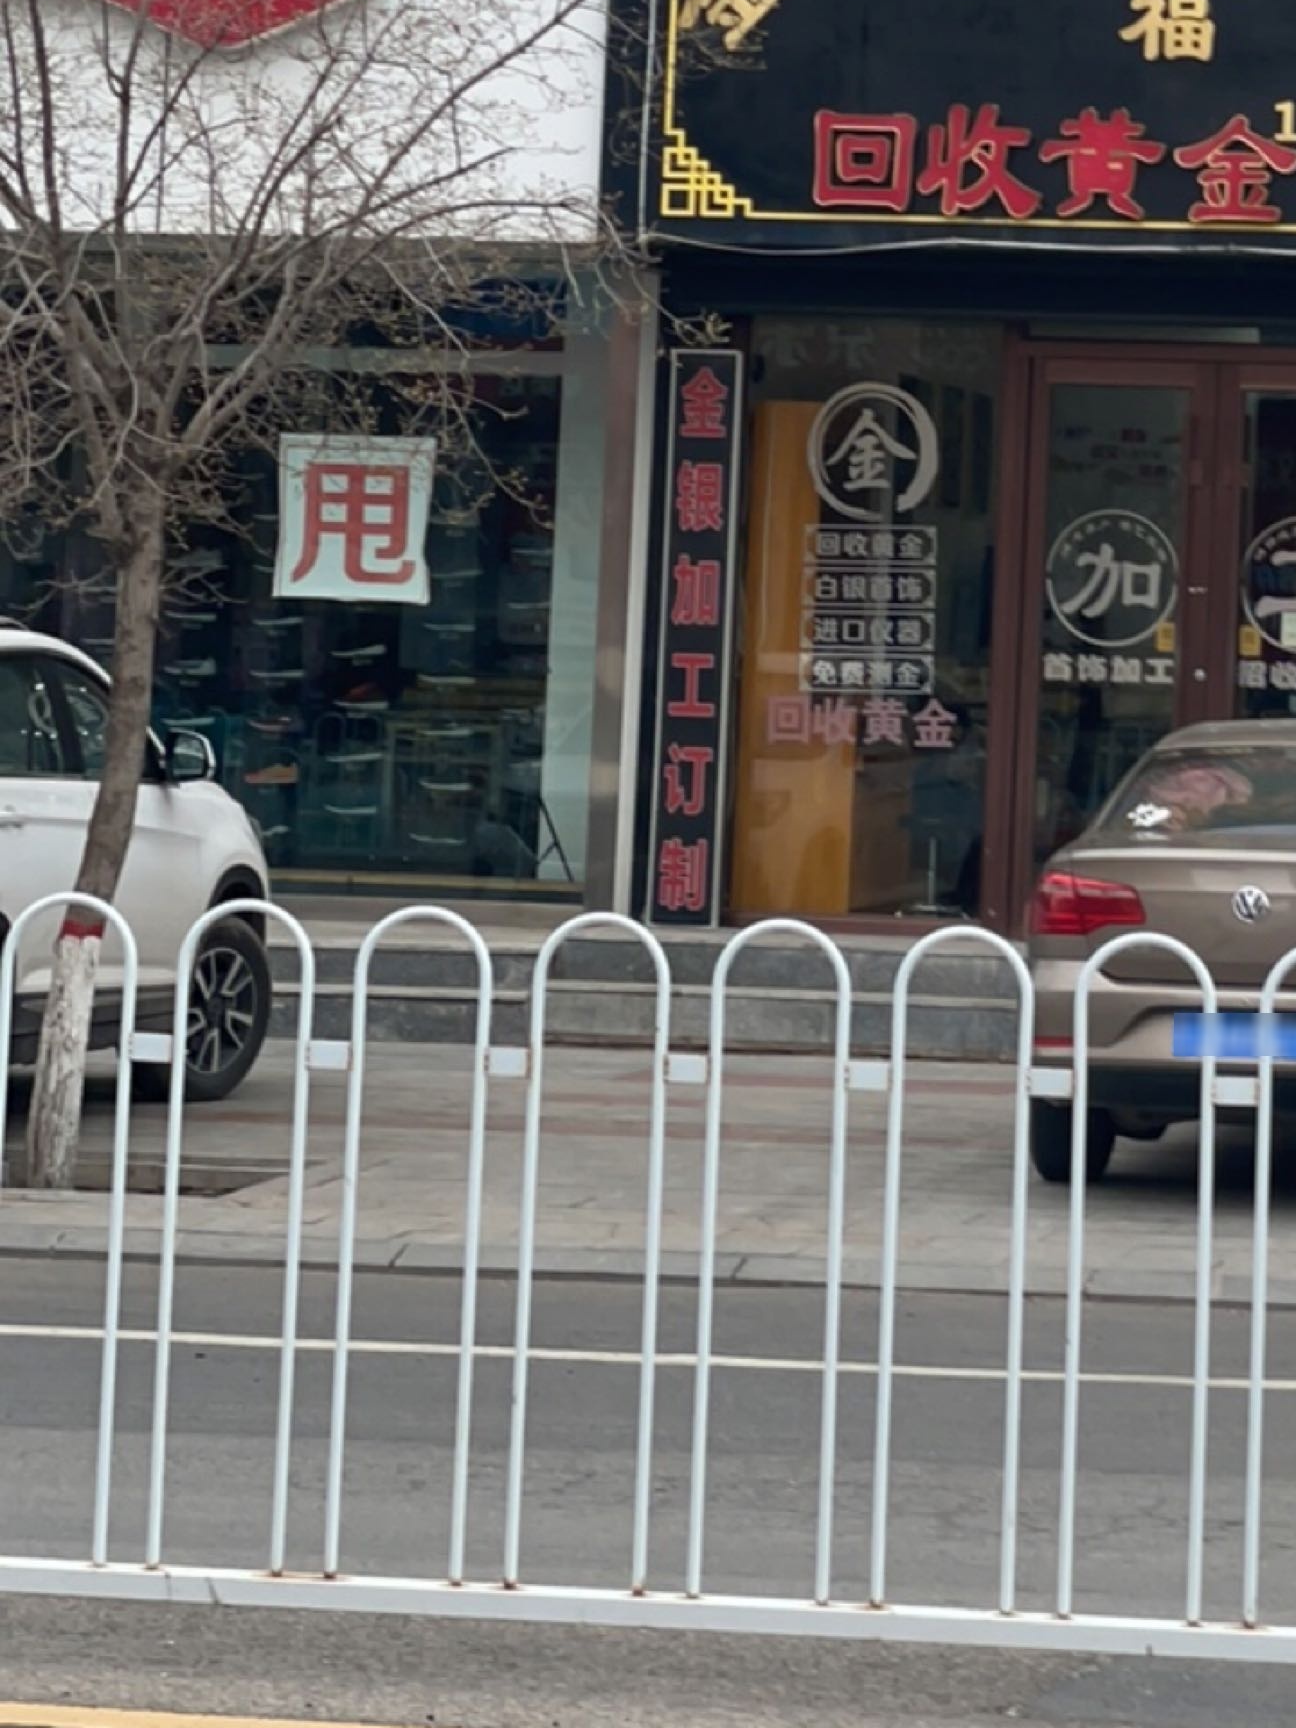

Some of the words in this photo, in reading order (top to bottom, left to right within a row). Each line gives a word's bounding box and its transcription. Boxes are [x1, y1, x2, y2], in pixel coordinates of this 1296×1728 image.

[826, 406, 918, 492] 金
[290, 461, 417, 585] 甩
[657, 365, 729, 914] 金银加工订制
[765, 695, 958, 750] 回收黄金
